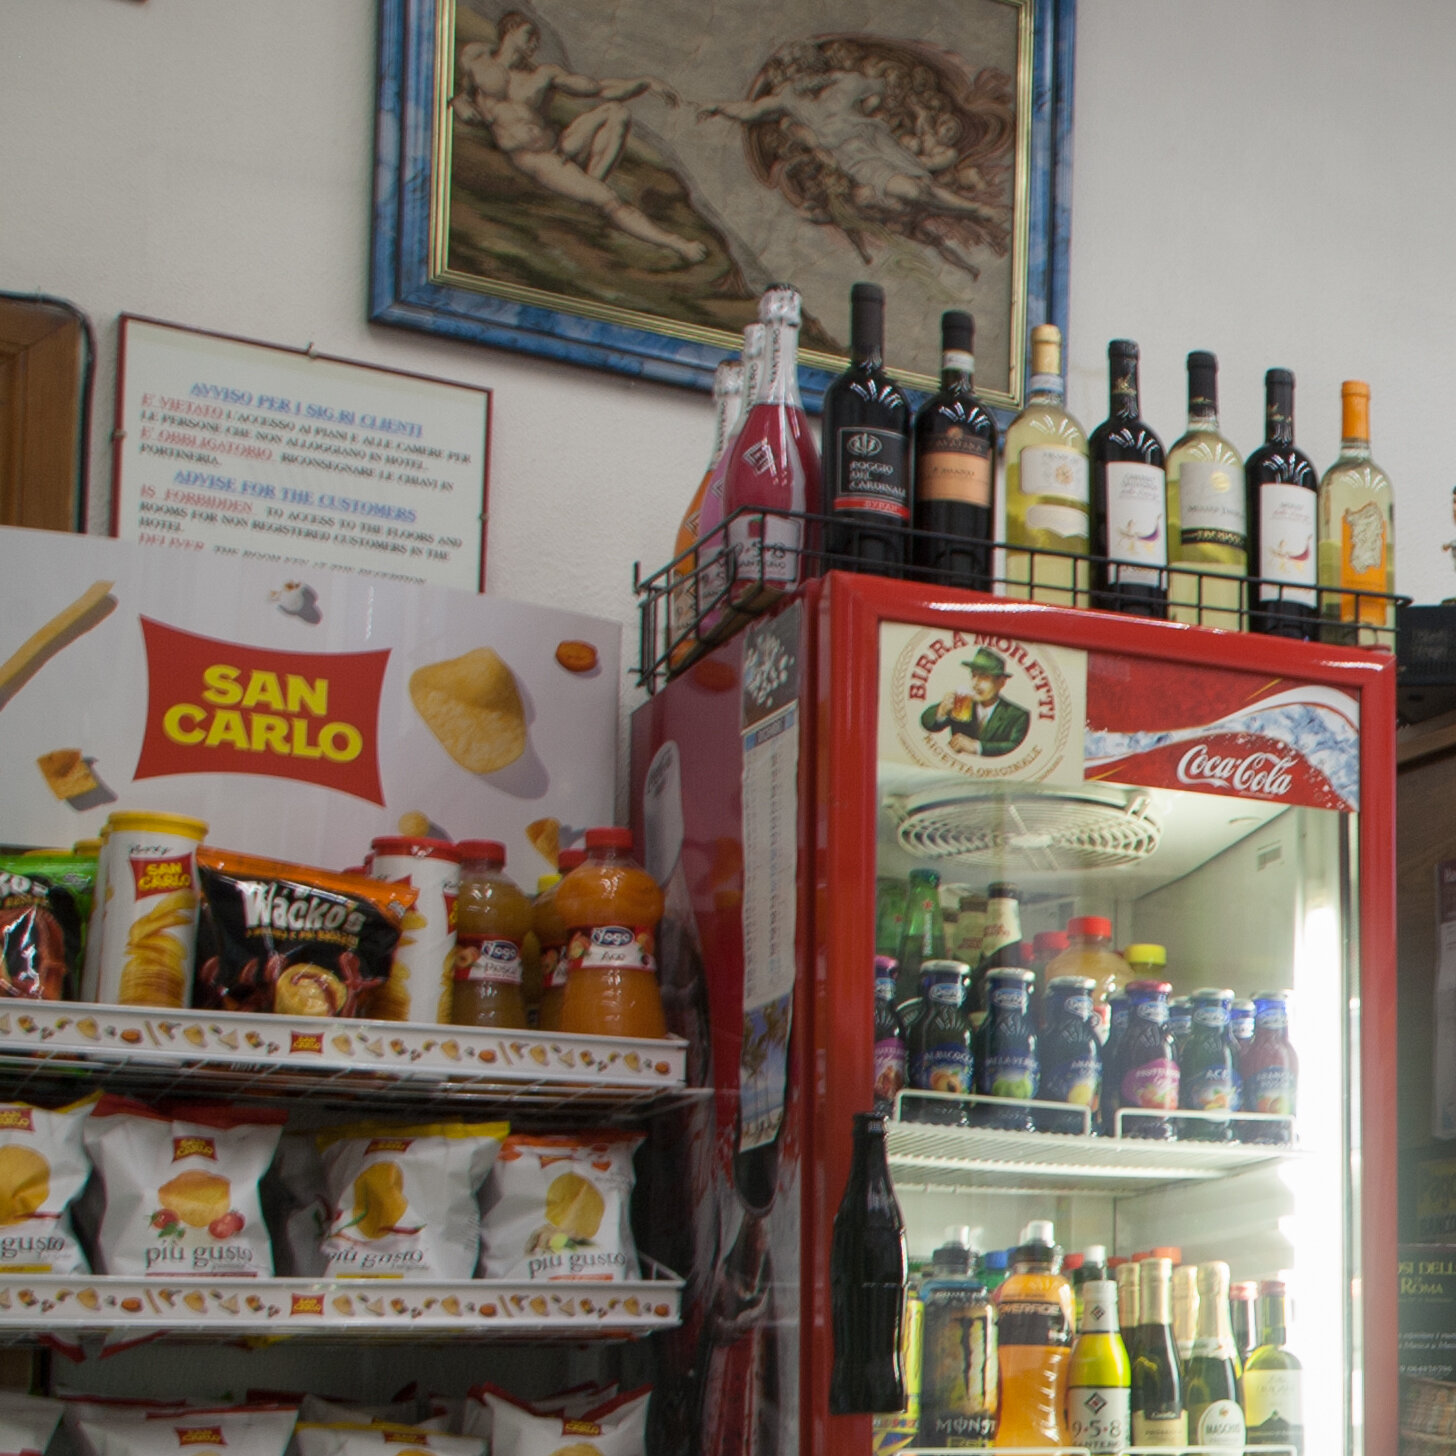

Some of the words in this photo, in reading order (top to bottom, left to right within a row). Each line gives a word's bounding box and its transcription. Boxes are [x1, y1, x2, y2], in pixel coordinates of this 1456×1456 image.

[160, 396, 224, 420] VIETATO
[190, 383, 253, 406] AVVISO
[257, 394, 291, 413] PER
[360, 414, 423, 439] CLIENTI
[158, 430, 274, 461] OBBLIGATORIO
[140, 484, 156, 498] IS
[164, 488, 254, 513] FORBIDDEN
[173, 469, 238, 492] ADVISE
[241, 480, 276, 499] FOR
[281, 487, 314, 505] THE
[318, 493, 418, 523] CUSTOMERS
[139, 501, 188, 518] ROOMS
[190, 509, 218, 522] FOR
[220, 514, 249, 527] NON
[333, 534, 408, 554] CUSTOMERS
[203, 664, 329, 717] SAN
[909, 631, 970, 702] BIRRA
[973, 632, 1056, 721] MORETTI
[163, 703, 364, 763] CARLO
[1176, 744, 1299, 795] Coca-Cola
[138, 874, 192, 890] CARLO
[146, 862, 184, 875] SAN
[1, 1236, 65, 1259] gusto
[193, 1245, 254, 1267] gusto
[570, 1252, 627, 1273] gusto
